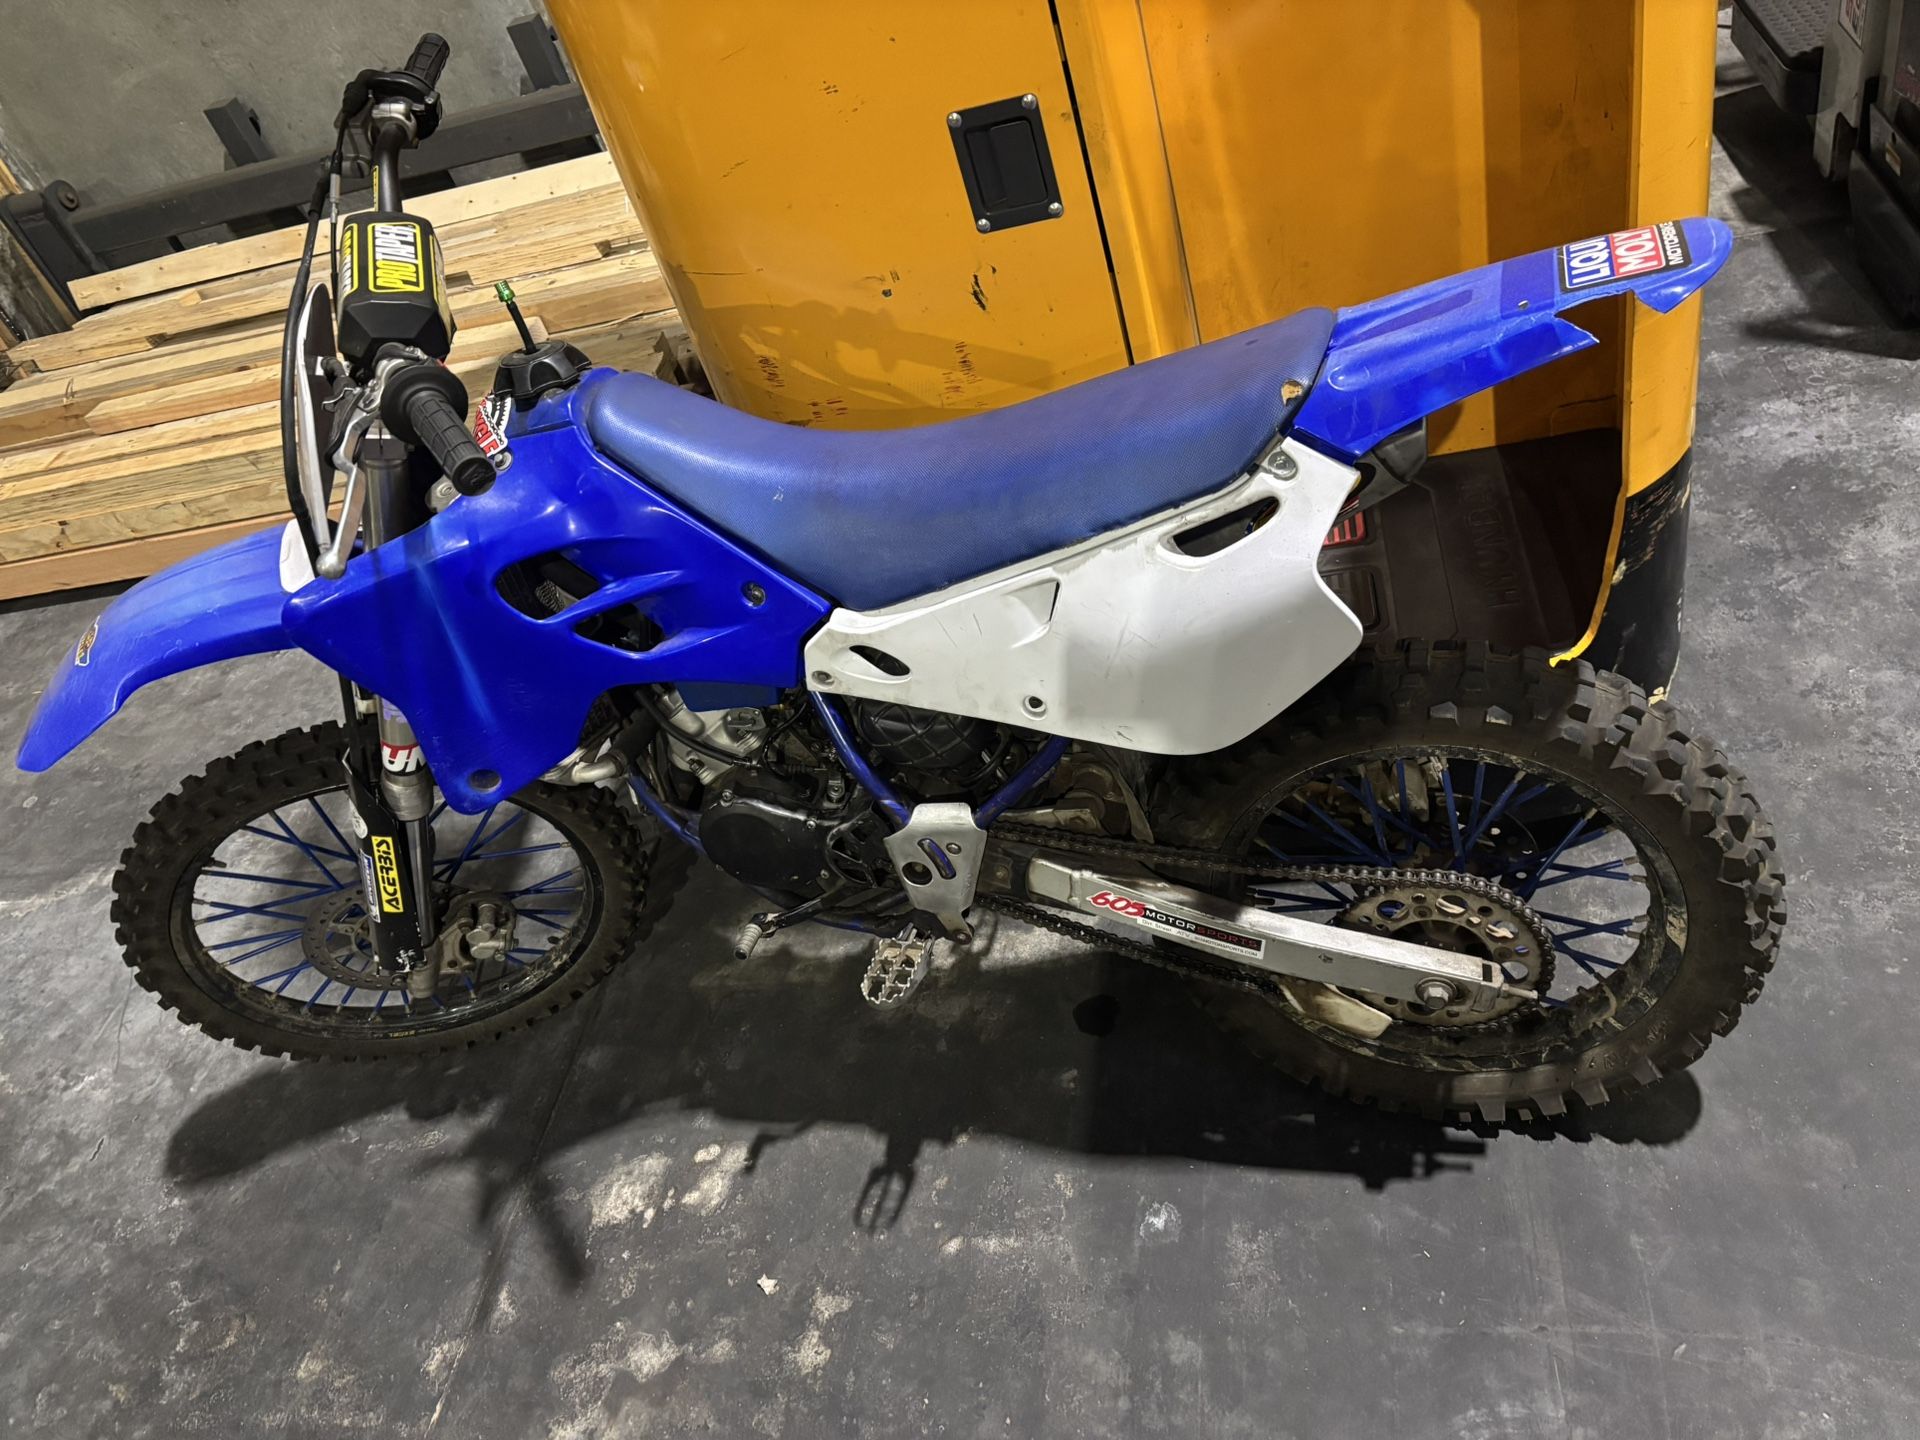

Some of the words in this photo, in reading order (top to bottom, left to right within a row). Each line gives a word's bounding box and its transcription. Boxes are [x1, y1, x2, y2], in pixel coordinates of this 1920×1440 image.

[374, 224, 419, 291] PROTAPER
[1569, 237, 1611, 284] LIQUI
[1612, 228, 1659, 273] MOLY
[1090, 891, 1146, 918] 605
[1146, 909, 1259, 950] MOTORSPORTS
